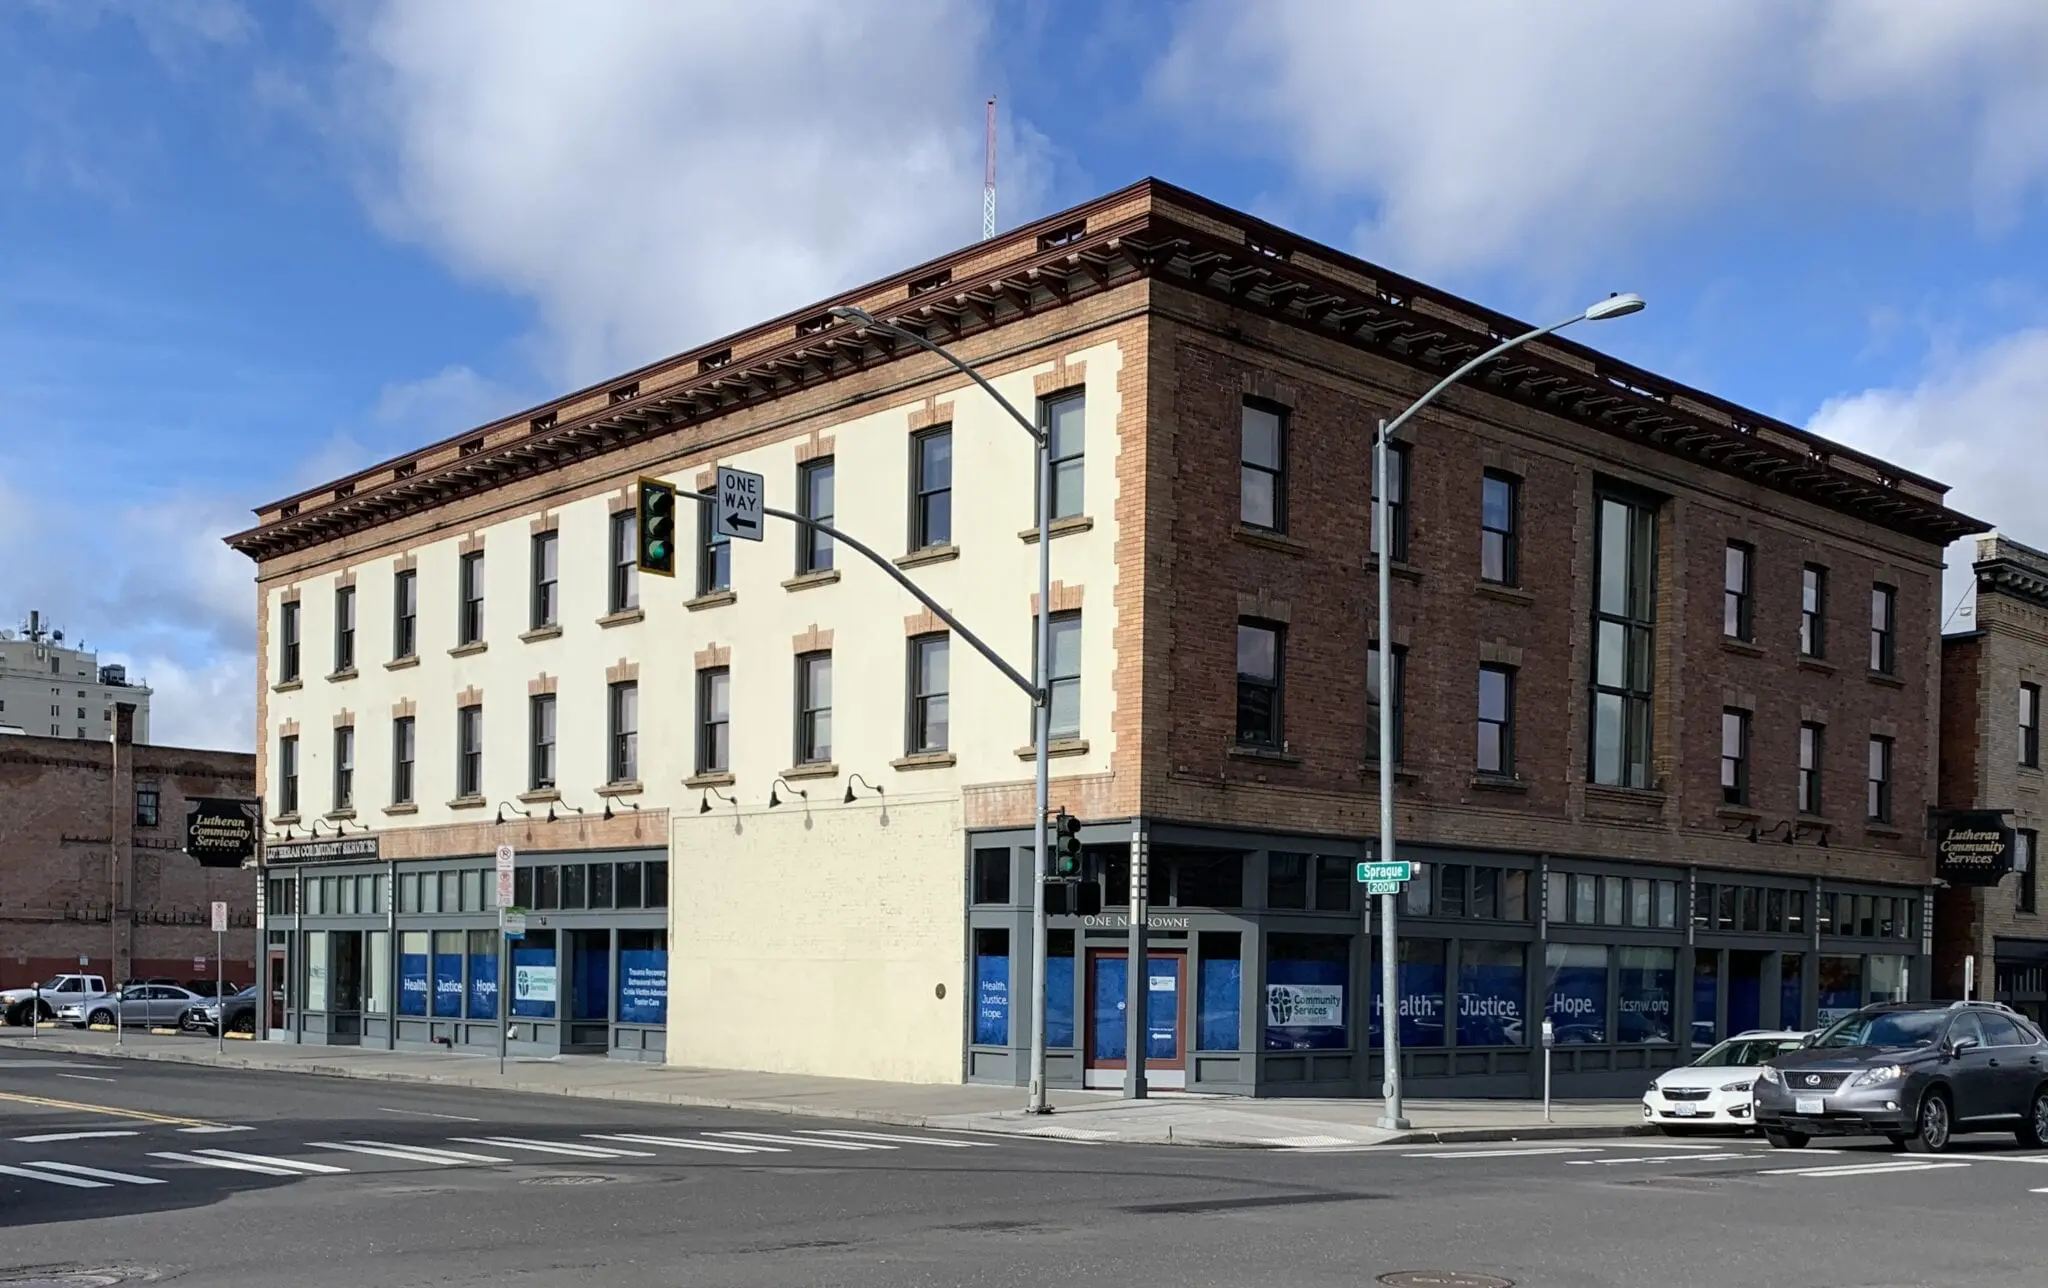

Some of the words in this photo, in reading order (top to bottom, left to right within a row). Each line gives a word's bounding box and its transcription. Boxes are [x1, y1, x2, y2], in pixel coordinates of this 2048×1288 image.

[726, 474, 756, 494] ONE
[725, 491, 757, 512] WAY
[196, 814, 245, 827] Lutheran
[190, 824, 250, 840] Community
[1947, 828, 2000, 841] Lutheran
[195, 835, 240, 847] Services
[1940, 841, 2005, 855] Community
[1945, 852, 1993, 864] Services
[1363, 864, 1404, 881] Sprague
[1084, 914, 1112, 926] ONE
[1146, 917, 1190, 928] ROWNE
[476, 979, 498, 995] Hope.
[982, 980, 1007, 991] Health.
[981, 994, 1009, 1005] Justice.
[1294, 994, 1341, 1008] Community
[1376, 994, 1436, 1017] Halth.
[1460, 995, 1519, 1017] Justice.
[1553, 992, 1596, 1019] Hope.
[981, 1007, 1004, 1020] Hope.
[1293, 1004, 1328, 1016] Services
